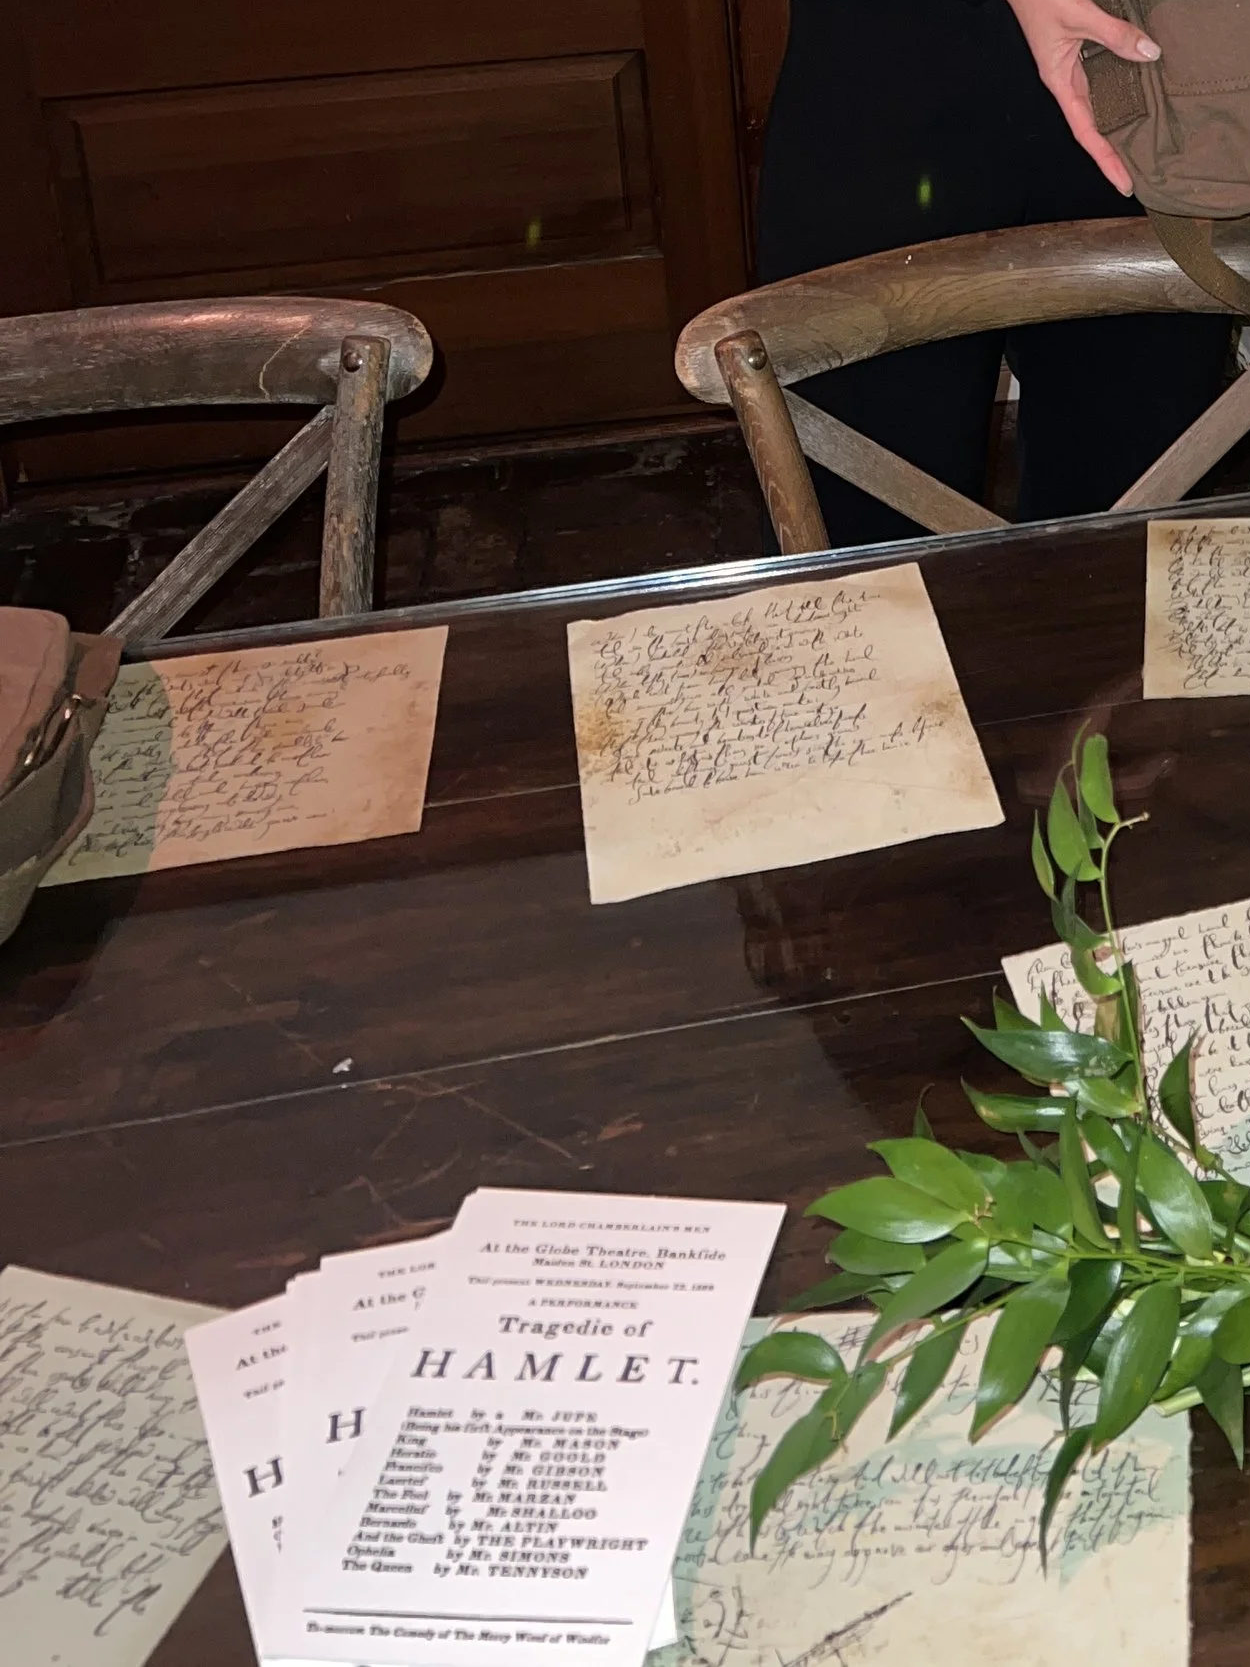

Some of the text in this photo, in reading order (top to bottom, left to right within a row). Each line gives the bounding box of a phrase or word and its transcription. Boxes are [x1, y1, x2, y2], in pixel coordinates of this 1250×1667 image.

[513, 1219, 538, 1228] THE
[541, 1220, 577, 1230] LORD
[683, 1225, 711, 1234] MEN
[479, 1241, 501, 1254] At
[504, 1242, 530, 1254] the
[535, 1243, 580, 1255] Globe
[377, 1261, 437, 1280] THE LOR
[599, 1259, 665, 1270] LONDON
[352, 1292, 375, 1312] At
[379, 1290, 407, 1307] the
[540, 1298, 639, 1310] PERFORMANCE
[498, 1314, 654, 1340] Tragedie of
[236, 1354, 259, 1371] At
[410, 1347, 700, 1386] HAMLET.
[407, 1406, 454, 1419] Hamlet
[471, 1407, 487, 1422] by
[551, 1409, 598, 1423] JUPE
[396, 1432, 428, 1446] King
[486, 1436, 504, 1450] by
[551, 1437, 621, 1451] MASON
[482, 1449, 498, 1464] by
[477, 1462, 493, 1477] by
[531, 1464, 606, 1478] GIBSON
[471, 1476, 487, 1490] by
[526, 1478, 608, 1492] RUSSELL
[373, 1487, 398, 1500] The
[446, 1488, 463, 1504] by
[497, 1492, 577, 1505] MARZAN
[445, 1504, 461, 1520] by
[510, 1506, 599, 1521] SHALLOO
[359, 1515, 417, 1529] Bernardo
[448, 1518, 466, 1534] by
[500, 1519, 561, 1534] ALTIN
[351, 1529, 381, 1542] And
[383, 1531, 405, 1543] the
[453, 1534, 472, 1549] by
[477, 1534, 516, 1547] THE
[521, 1535, 650, 1552] PLAYWRIGHT
[346, 1542, 397, 1558] Ophelia
[445, 1547, 464, 1563] by
[498, 1550, 571, 1564] SIMONS
[341, 1556, 368, 1571] The
[370, 1560, 415, 1574] Queen
[433, 1562, 452, 1578] by
[487, 1565, 590, 1580] TENNYSON
[369, 1622, 391, 1637] The
